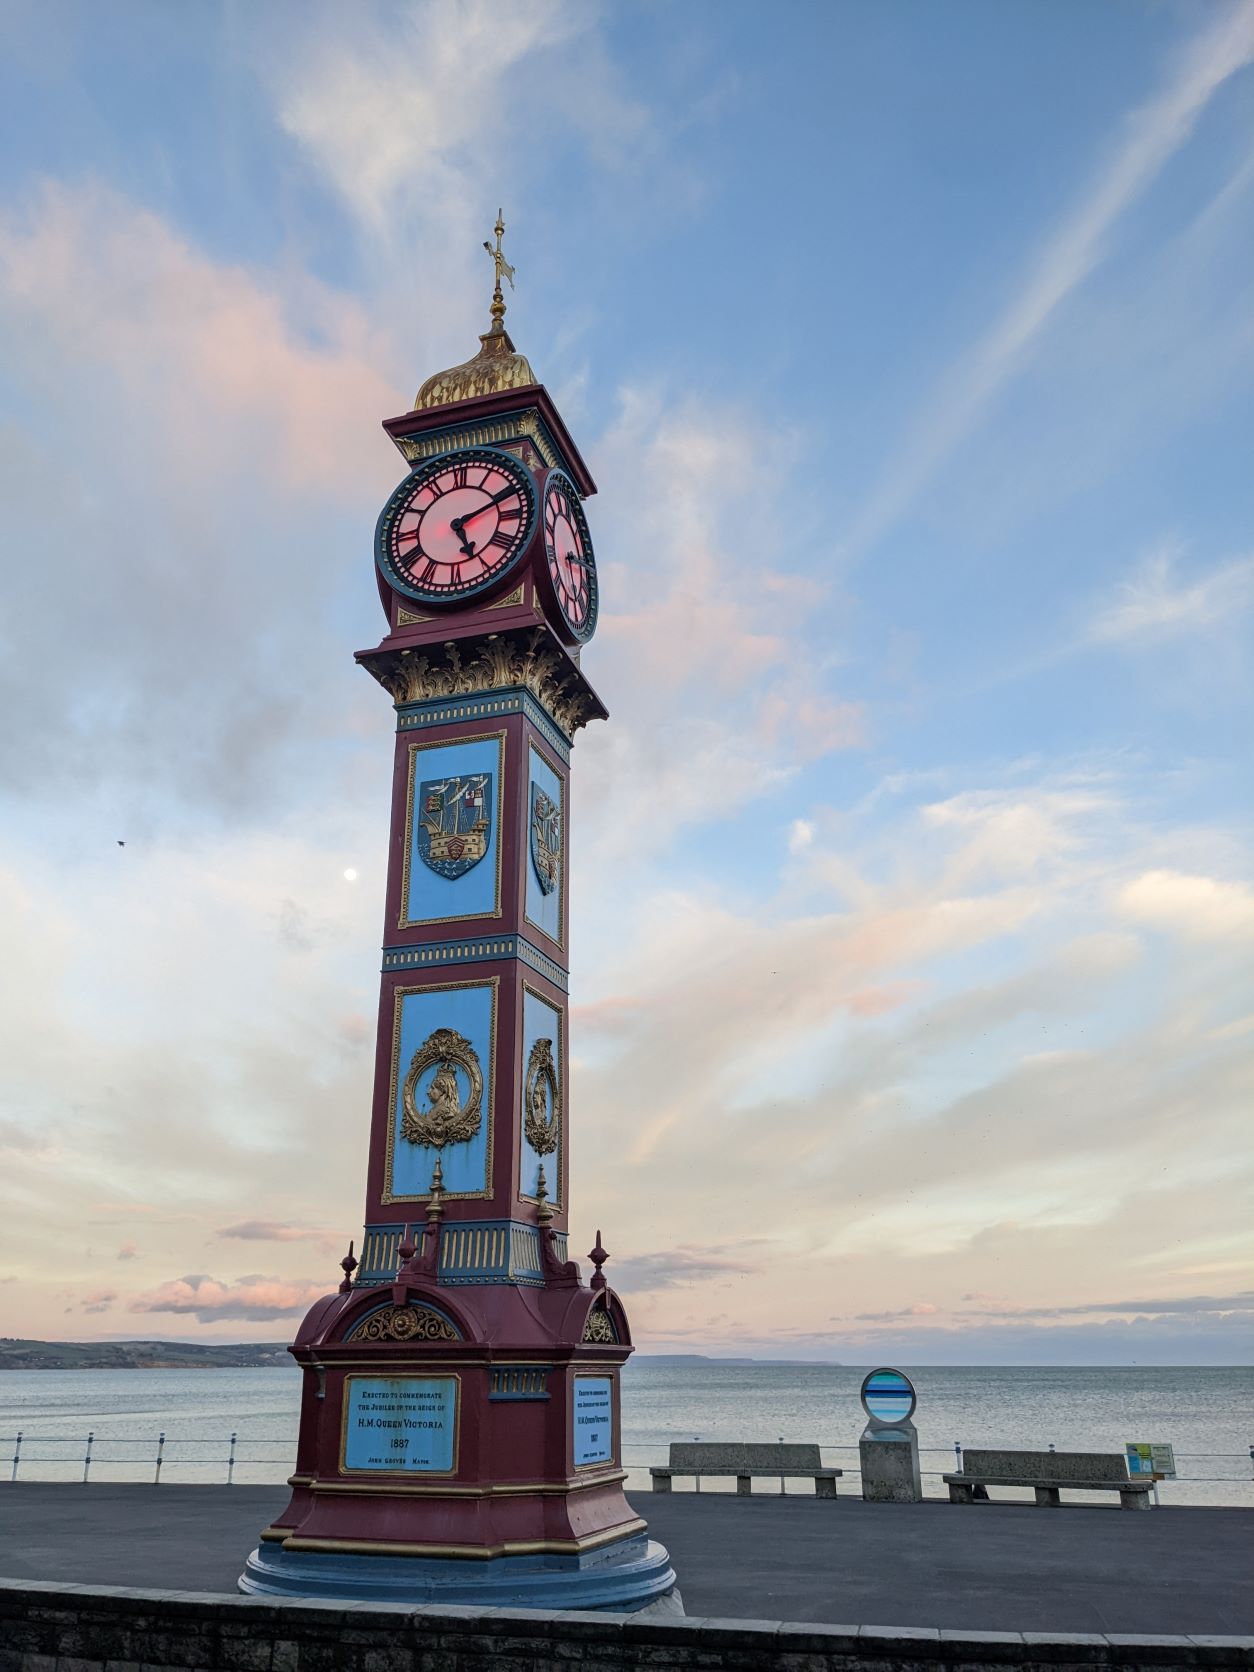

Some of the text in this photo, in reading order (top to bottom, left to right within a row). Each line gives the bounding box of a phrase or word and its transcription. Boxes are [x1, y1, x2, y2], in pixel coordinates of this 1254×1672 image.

[452, 466, 468, 489] XII
[427, 480, 443, 499] XI
[497, 508, 522, 522] III
[490, 530, 515, 550] IIII
[450, 563, 462, 584] VI
[362, 1391, 389, 1399] ERECTED
[370, 1403, 396, 1411] JUBILEE
[403, 1418, 443, 1429] VICTORIA
[390, 1438, 410, 1448] 1887
